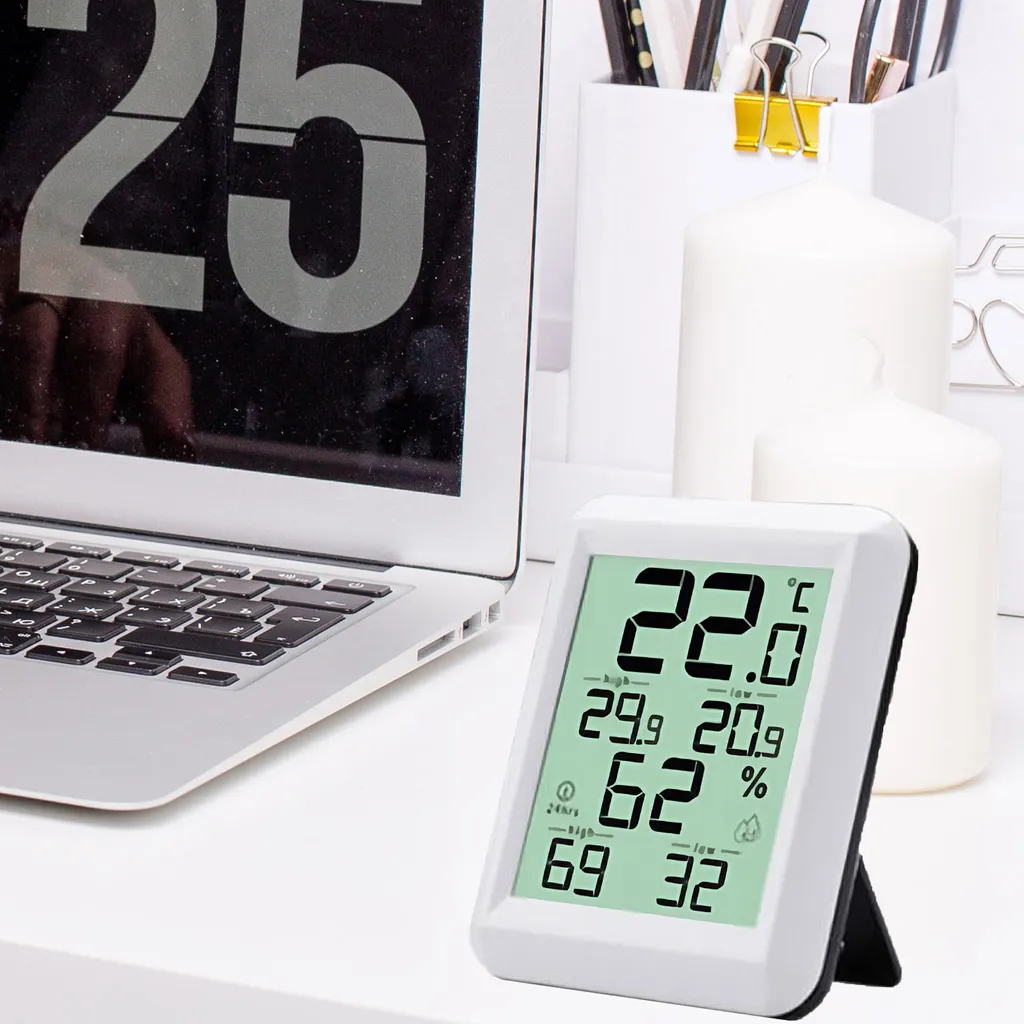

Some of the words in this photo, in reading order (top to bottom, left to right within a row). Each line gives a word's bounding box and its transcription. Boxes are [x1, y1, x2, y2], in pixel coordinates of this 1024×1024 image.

[617, 567, 807, 686] 22.0
[579, 688, 664, 745] 29.9
[692, 700, 784, 758] 20.9
[598, 752, 705, 835] 62
[741, 766, 767, 799] %
[542, 837, 610, 898] 69
[656, 853, 728, 913] 32
